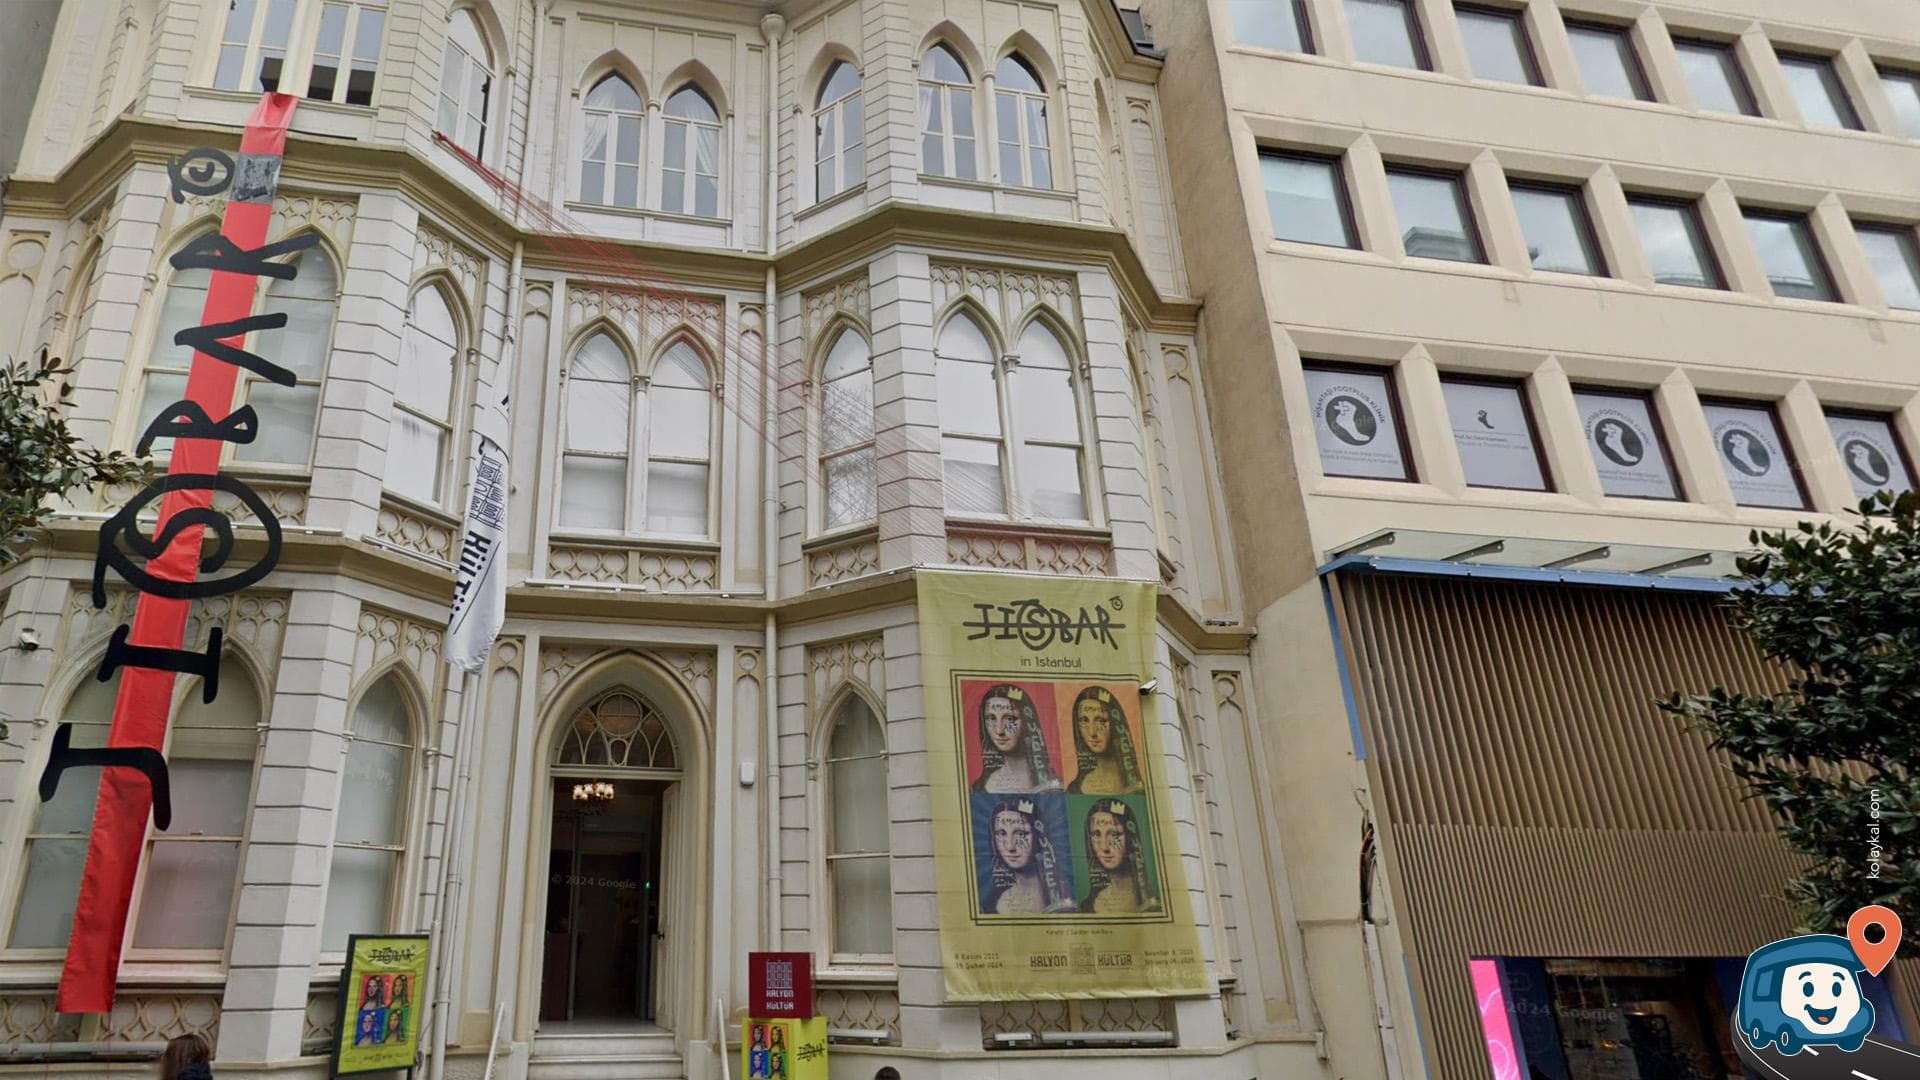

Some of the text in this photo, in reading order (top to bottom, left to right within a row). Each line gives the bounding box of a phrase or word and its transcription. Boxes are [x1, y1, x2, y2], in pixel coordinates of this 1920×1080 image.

[1333, 385, 1370, 402] FOOTPLUS
[449, 530, 492, 625] KÜLT
[965, 599, 1121, 651] JISBAR
[1020, 656, 1032, 667] in
[1098, 954, 1133, 966] KÜLTÜR
